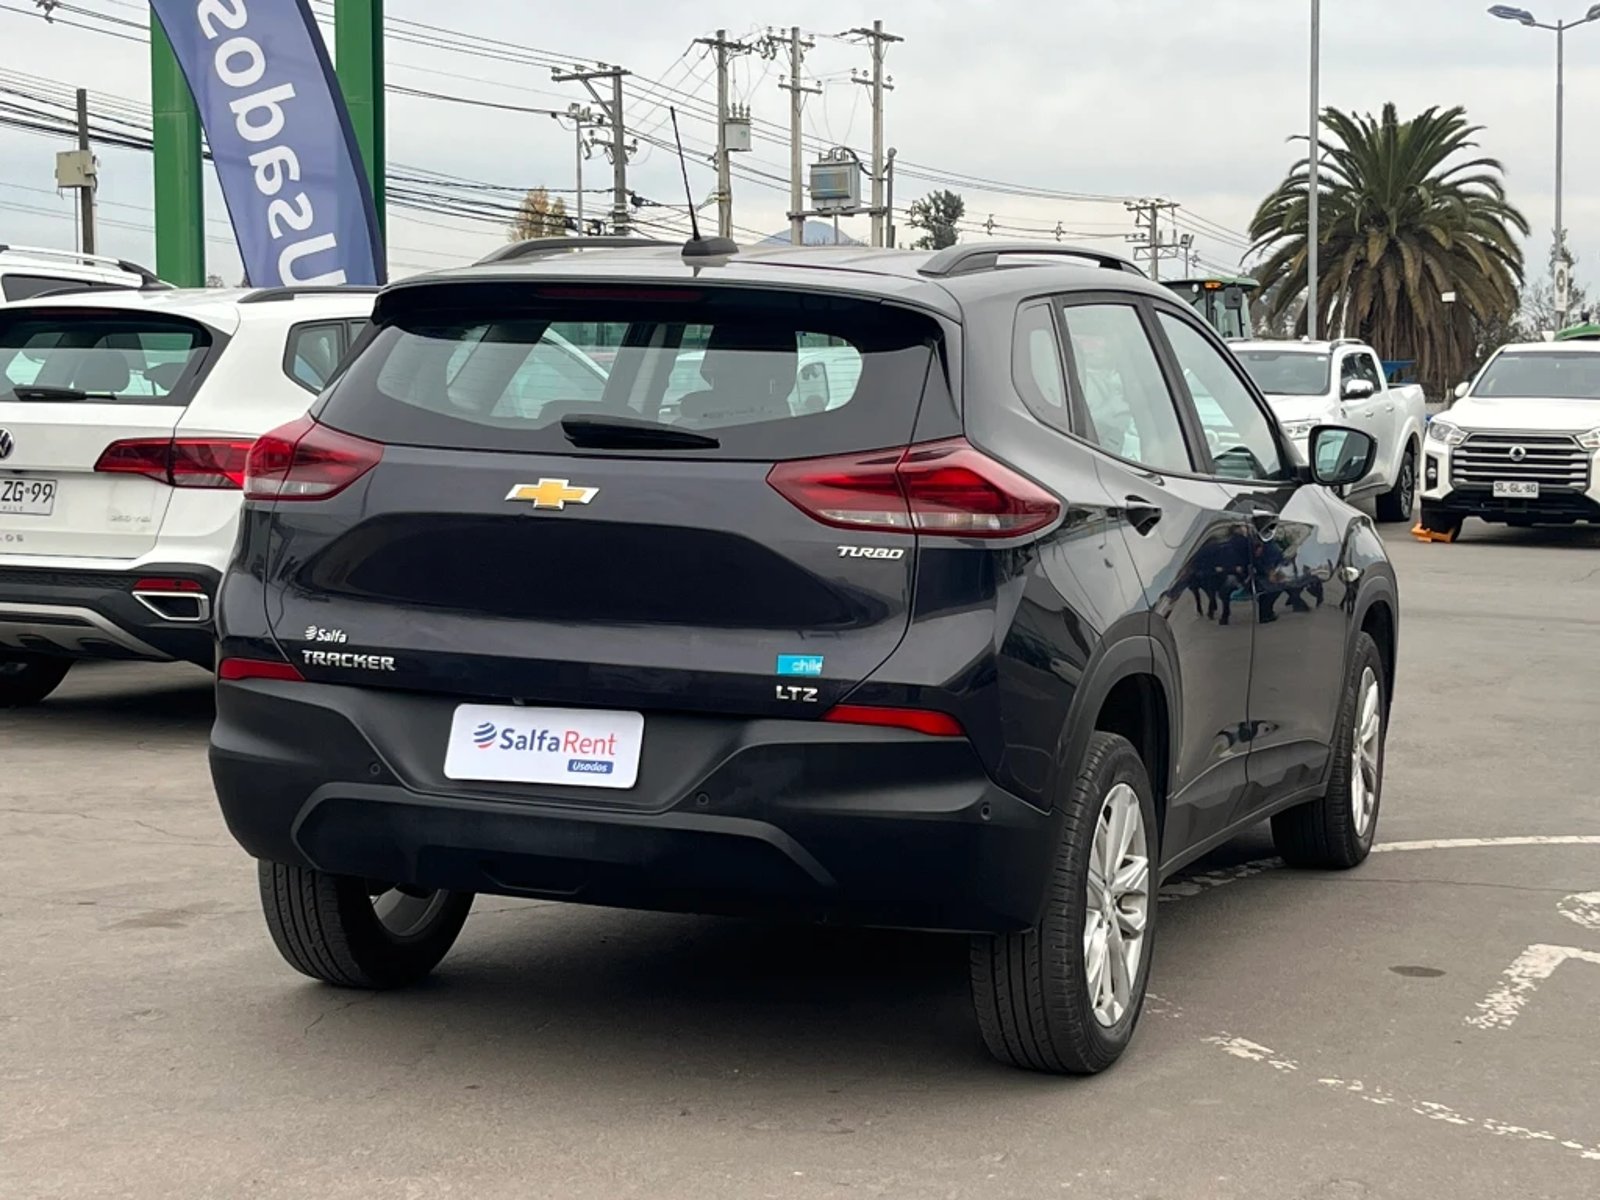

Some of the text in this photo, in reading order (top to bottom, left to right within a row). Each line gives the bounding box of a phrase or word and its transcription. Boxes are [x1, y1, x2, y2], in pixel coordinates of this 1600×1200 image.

[837, 545, 905, 559] TURBO
[316, 628, 348, 643] Salfa
[301, 649, 396, 671] TRACKER
[775, 685, 818, 702] LTZ
[571, 760, 609, 773] Usados
